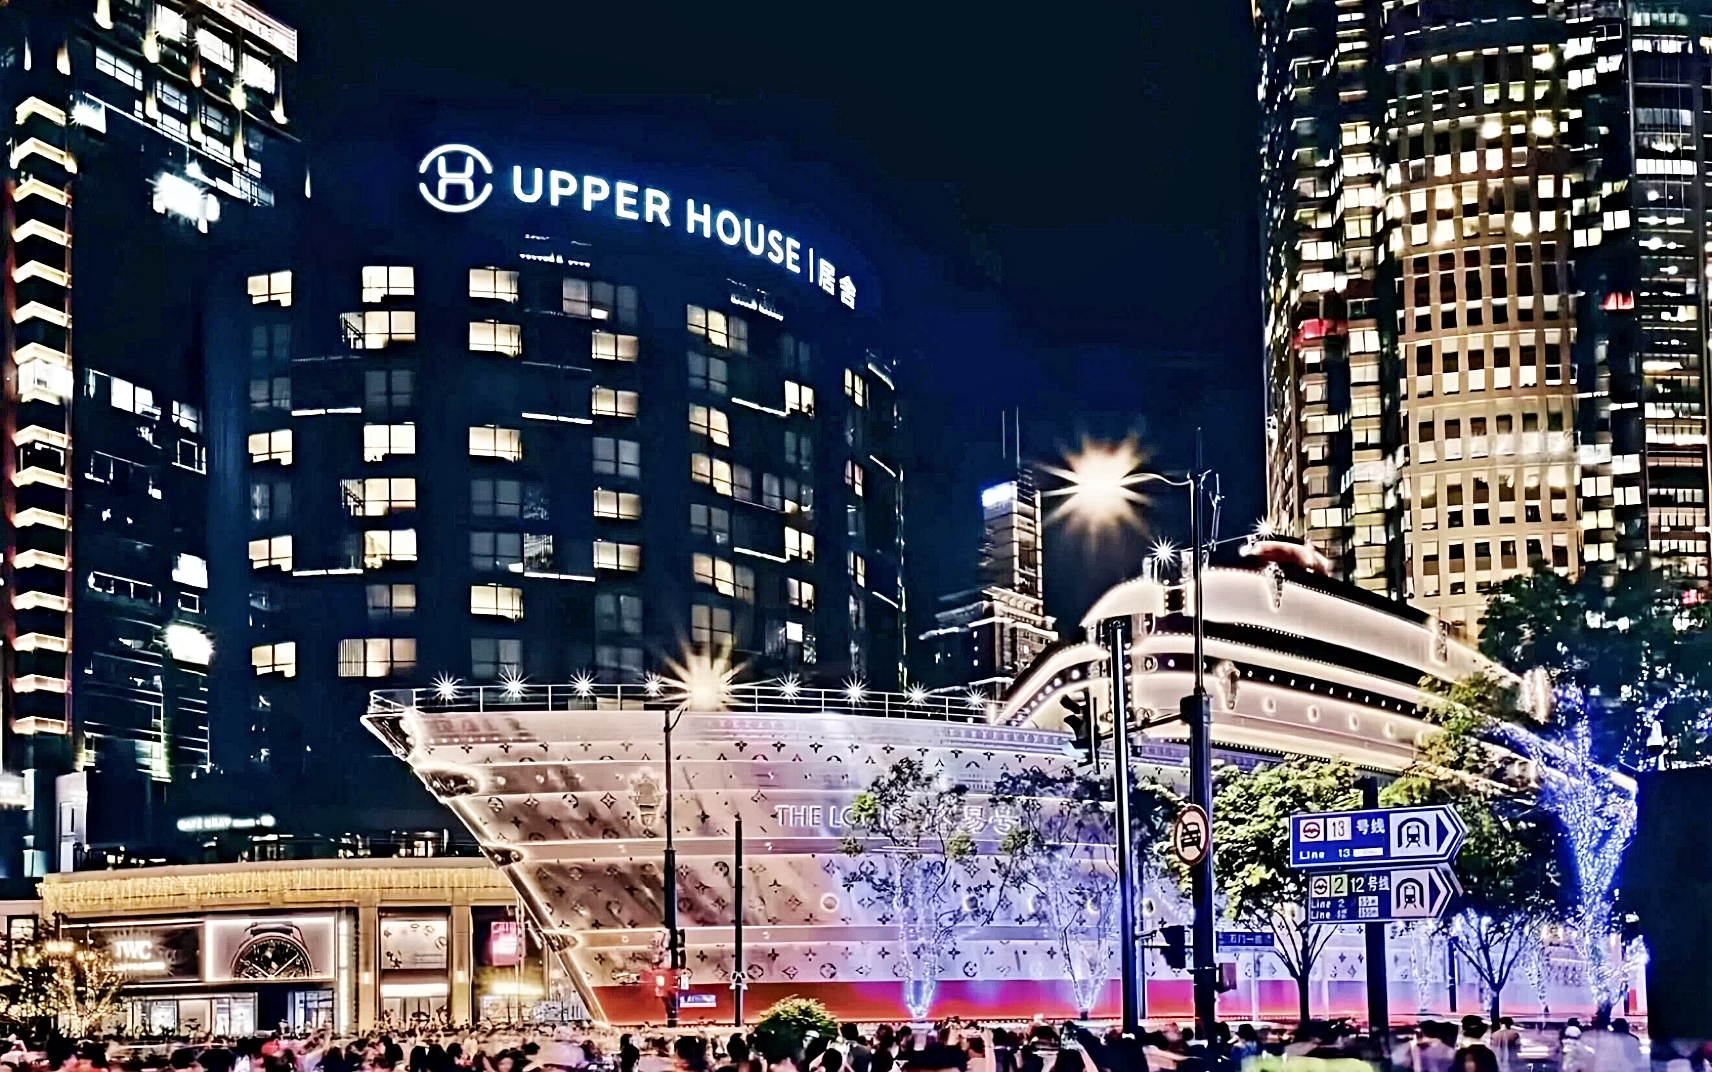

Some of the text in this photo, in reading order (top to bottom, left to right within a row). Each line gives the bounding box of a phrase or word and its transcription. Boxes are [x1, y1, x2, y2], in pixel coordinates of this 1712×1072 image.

[512, 164, 801, 274] UPPER HOUSE
[818, 257, 857, 310] 居舍
[774, 804, 822, 827] THE
[1332, 820, 1345, 838] 13
[1300, 850, 1325, 860] Line
[1337, 848, 1351, 858] 13
[1333, 876, 1345, 894] 2
[1310, 898, 1346, 909] Line 2
[1310, 909, 1332, 920] Line
[114, 940, 153, 960] IWC
